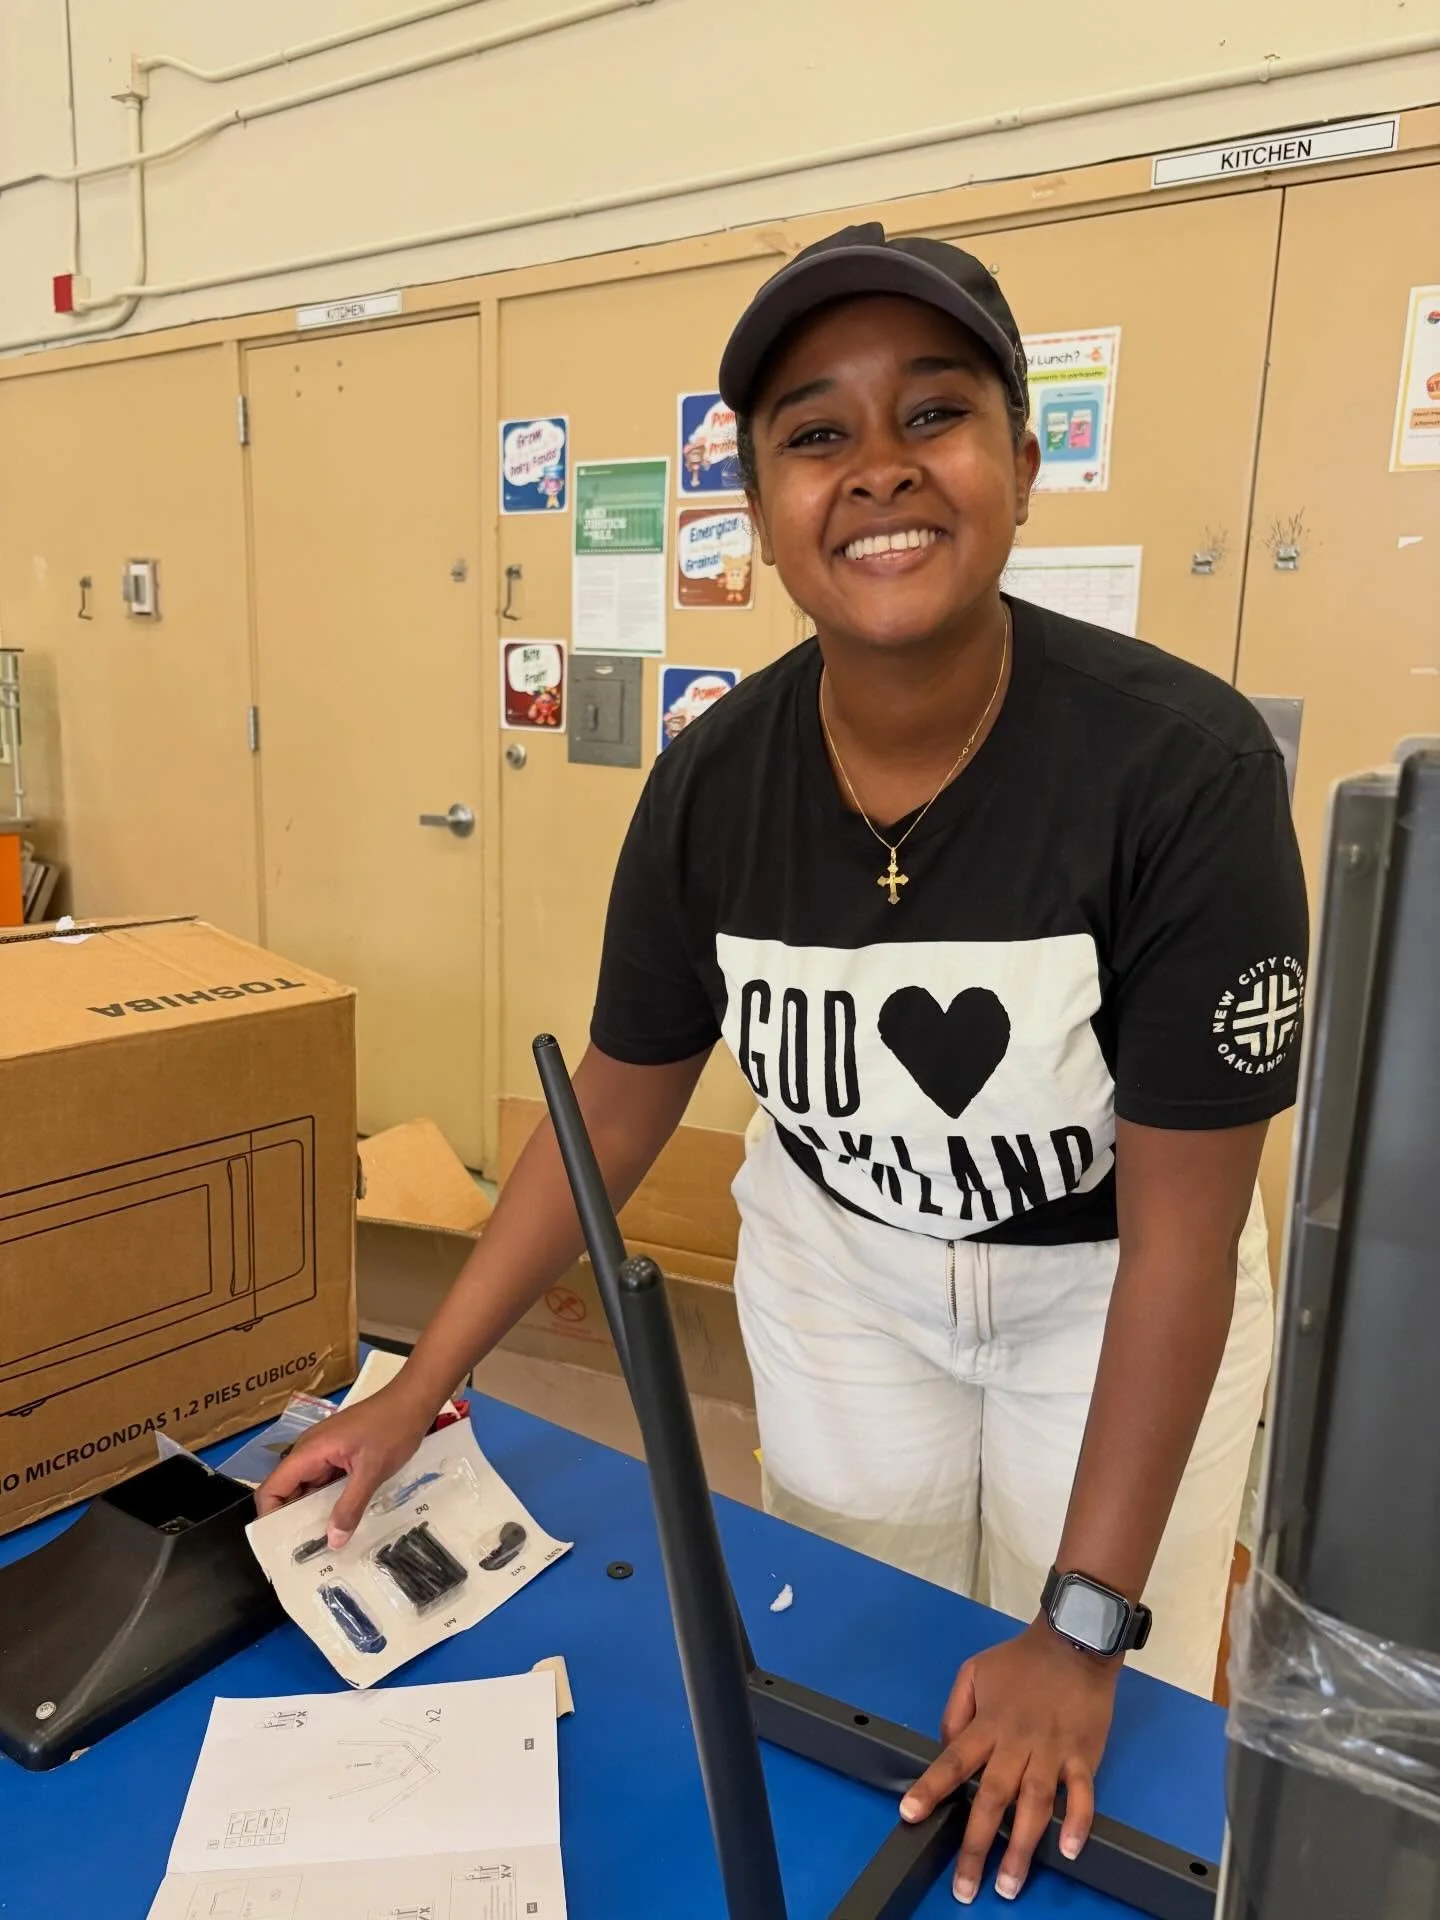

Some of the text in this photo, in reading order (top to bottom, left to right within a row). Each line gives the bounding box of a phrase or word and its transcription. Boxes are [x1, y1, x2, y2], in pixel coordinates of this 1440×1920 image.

[1220, 139, 1313, 170] KITCHEN
[326, 303, 366, 321] KITCHEN
[1036, 349, 1081, 366] Lunch?
[85, 977, 307, 1018] TOSHIBA
[1212, 990, 1235, 1033] NEW
[1238, 956, 1277, 985] CITY
[738, 978, 861, 1119] GOD
[0, 1351, 318, 1495] O MICROONDAS 1.2 PIES CUBICOS
[318, 1564, 334, 1577] Bx2
